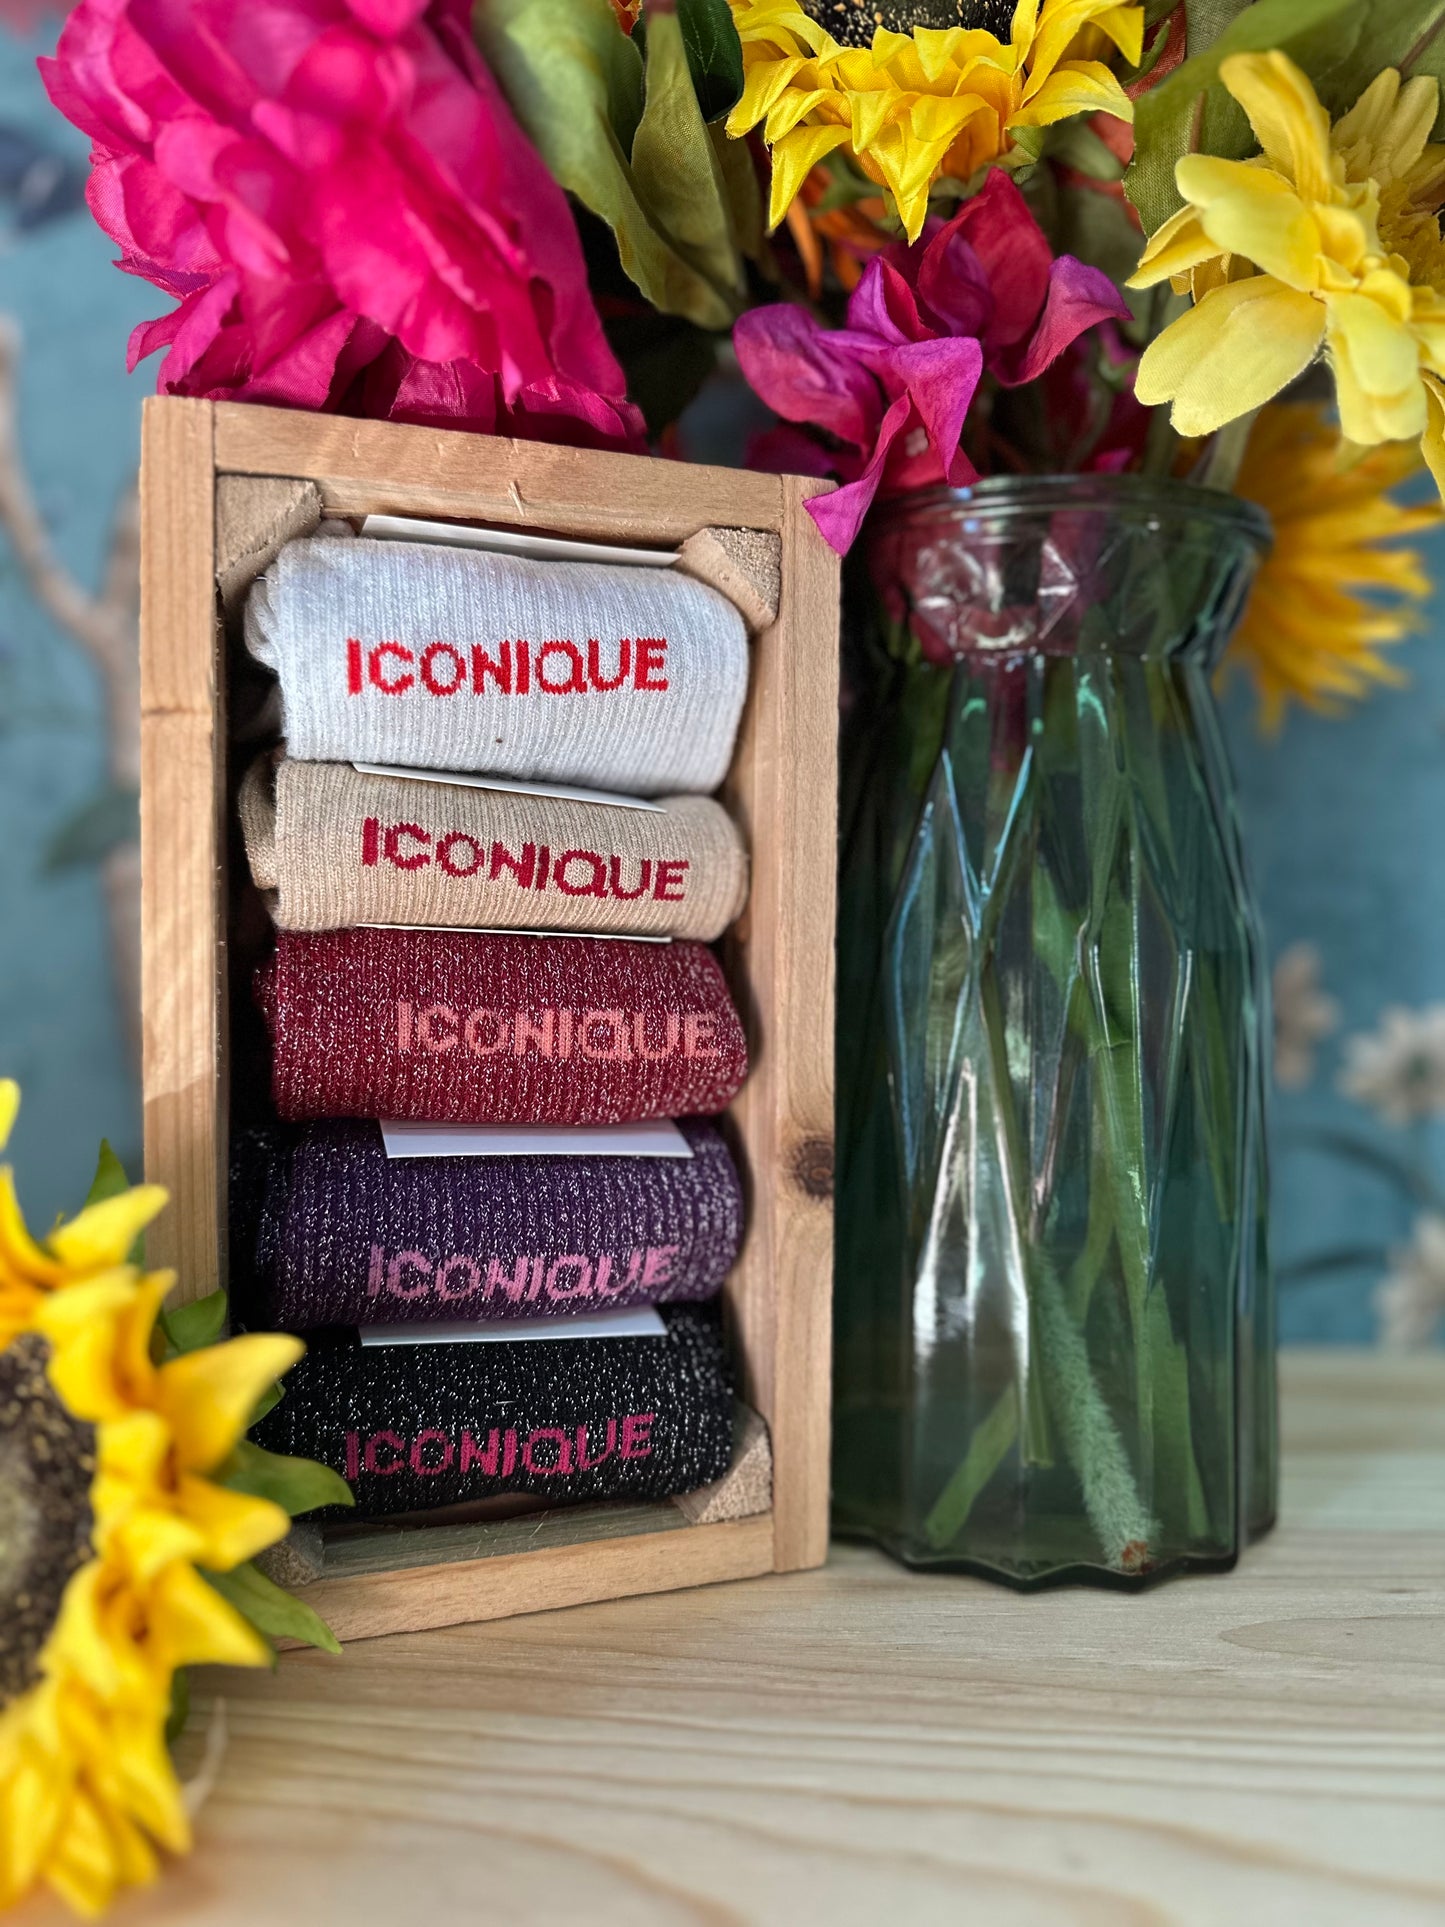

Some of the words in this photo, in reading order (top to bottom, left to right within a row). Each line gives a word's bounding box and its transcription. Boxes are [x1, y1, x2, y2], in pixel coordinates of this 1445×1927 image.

[346, 637, 669, 696] ICONIQUE
[362, 817, 690, 901] ICONIQUE
[399, 1002, 721, 1061] ICONIQUE
[367, 1244, 680, 1302] ICONIQUE
[345, 1413, 656, 1480] ICONIQUE
